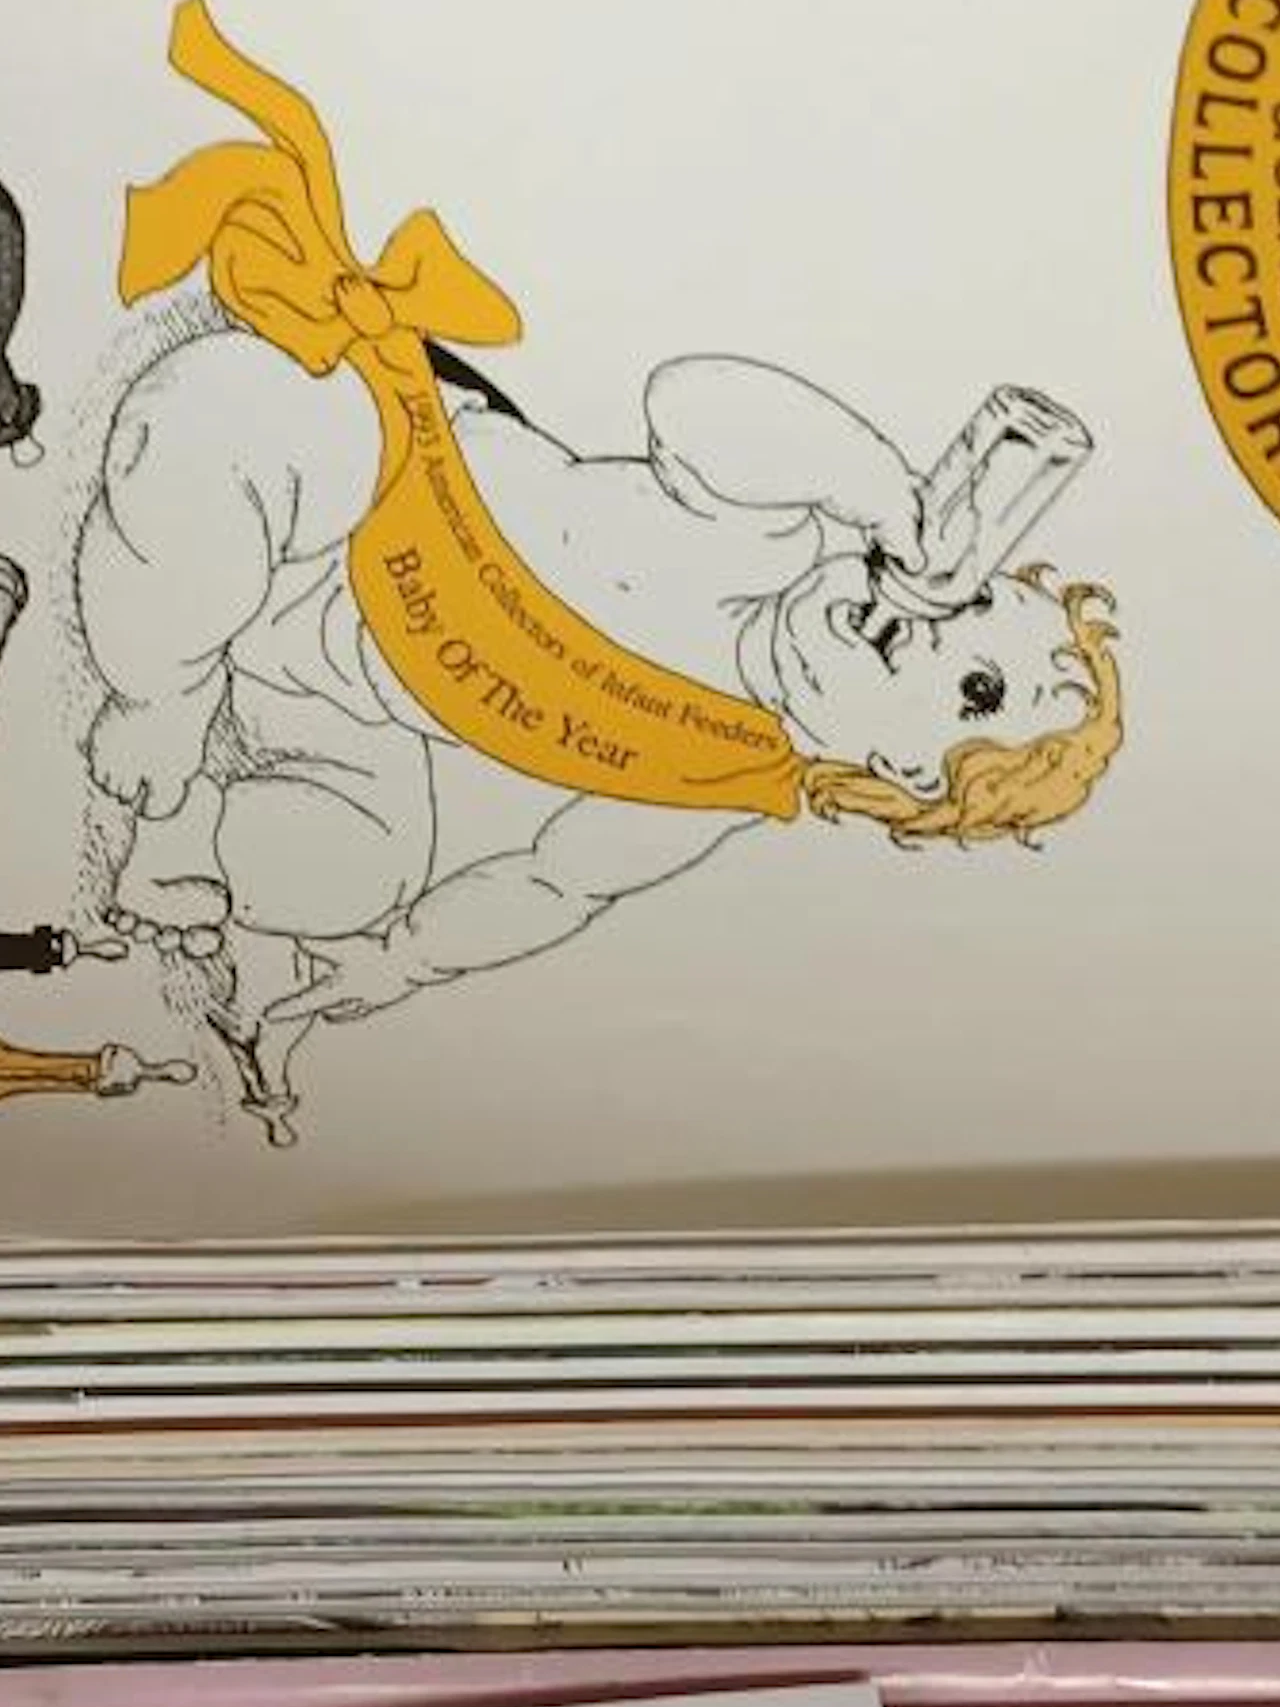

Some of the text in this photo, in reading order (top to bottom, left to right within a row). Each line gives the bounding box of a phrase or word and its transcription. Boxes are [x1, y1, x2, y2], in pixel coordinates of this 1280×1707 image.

[383, 545, 642, 773] Baby Of The Year
[422, 454, 484, 564] American
[477, 561, 566, 661] Collectors
[570, 655, 604, 683] of
[599, 671, 672, 720] Infant
[675, 703, 780, 753] Feeders
